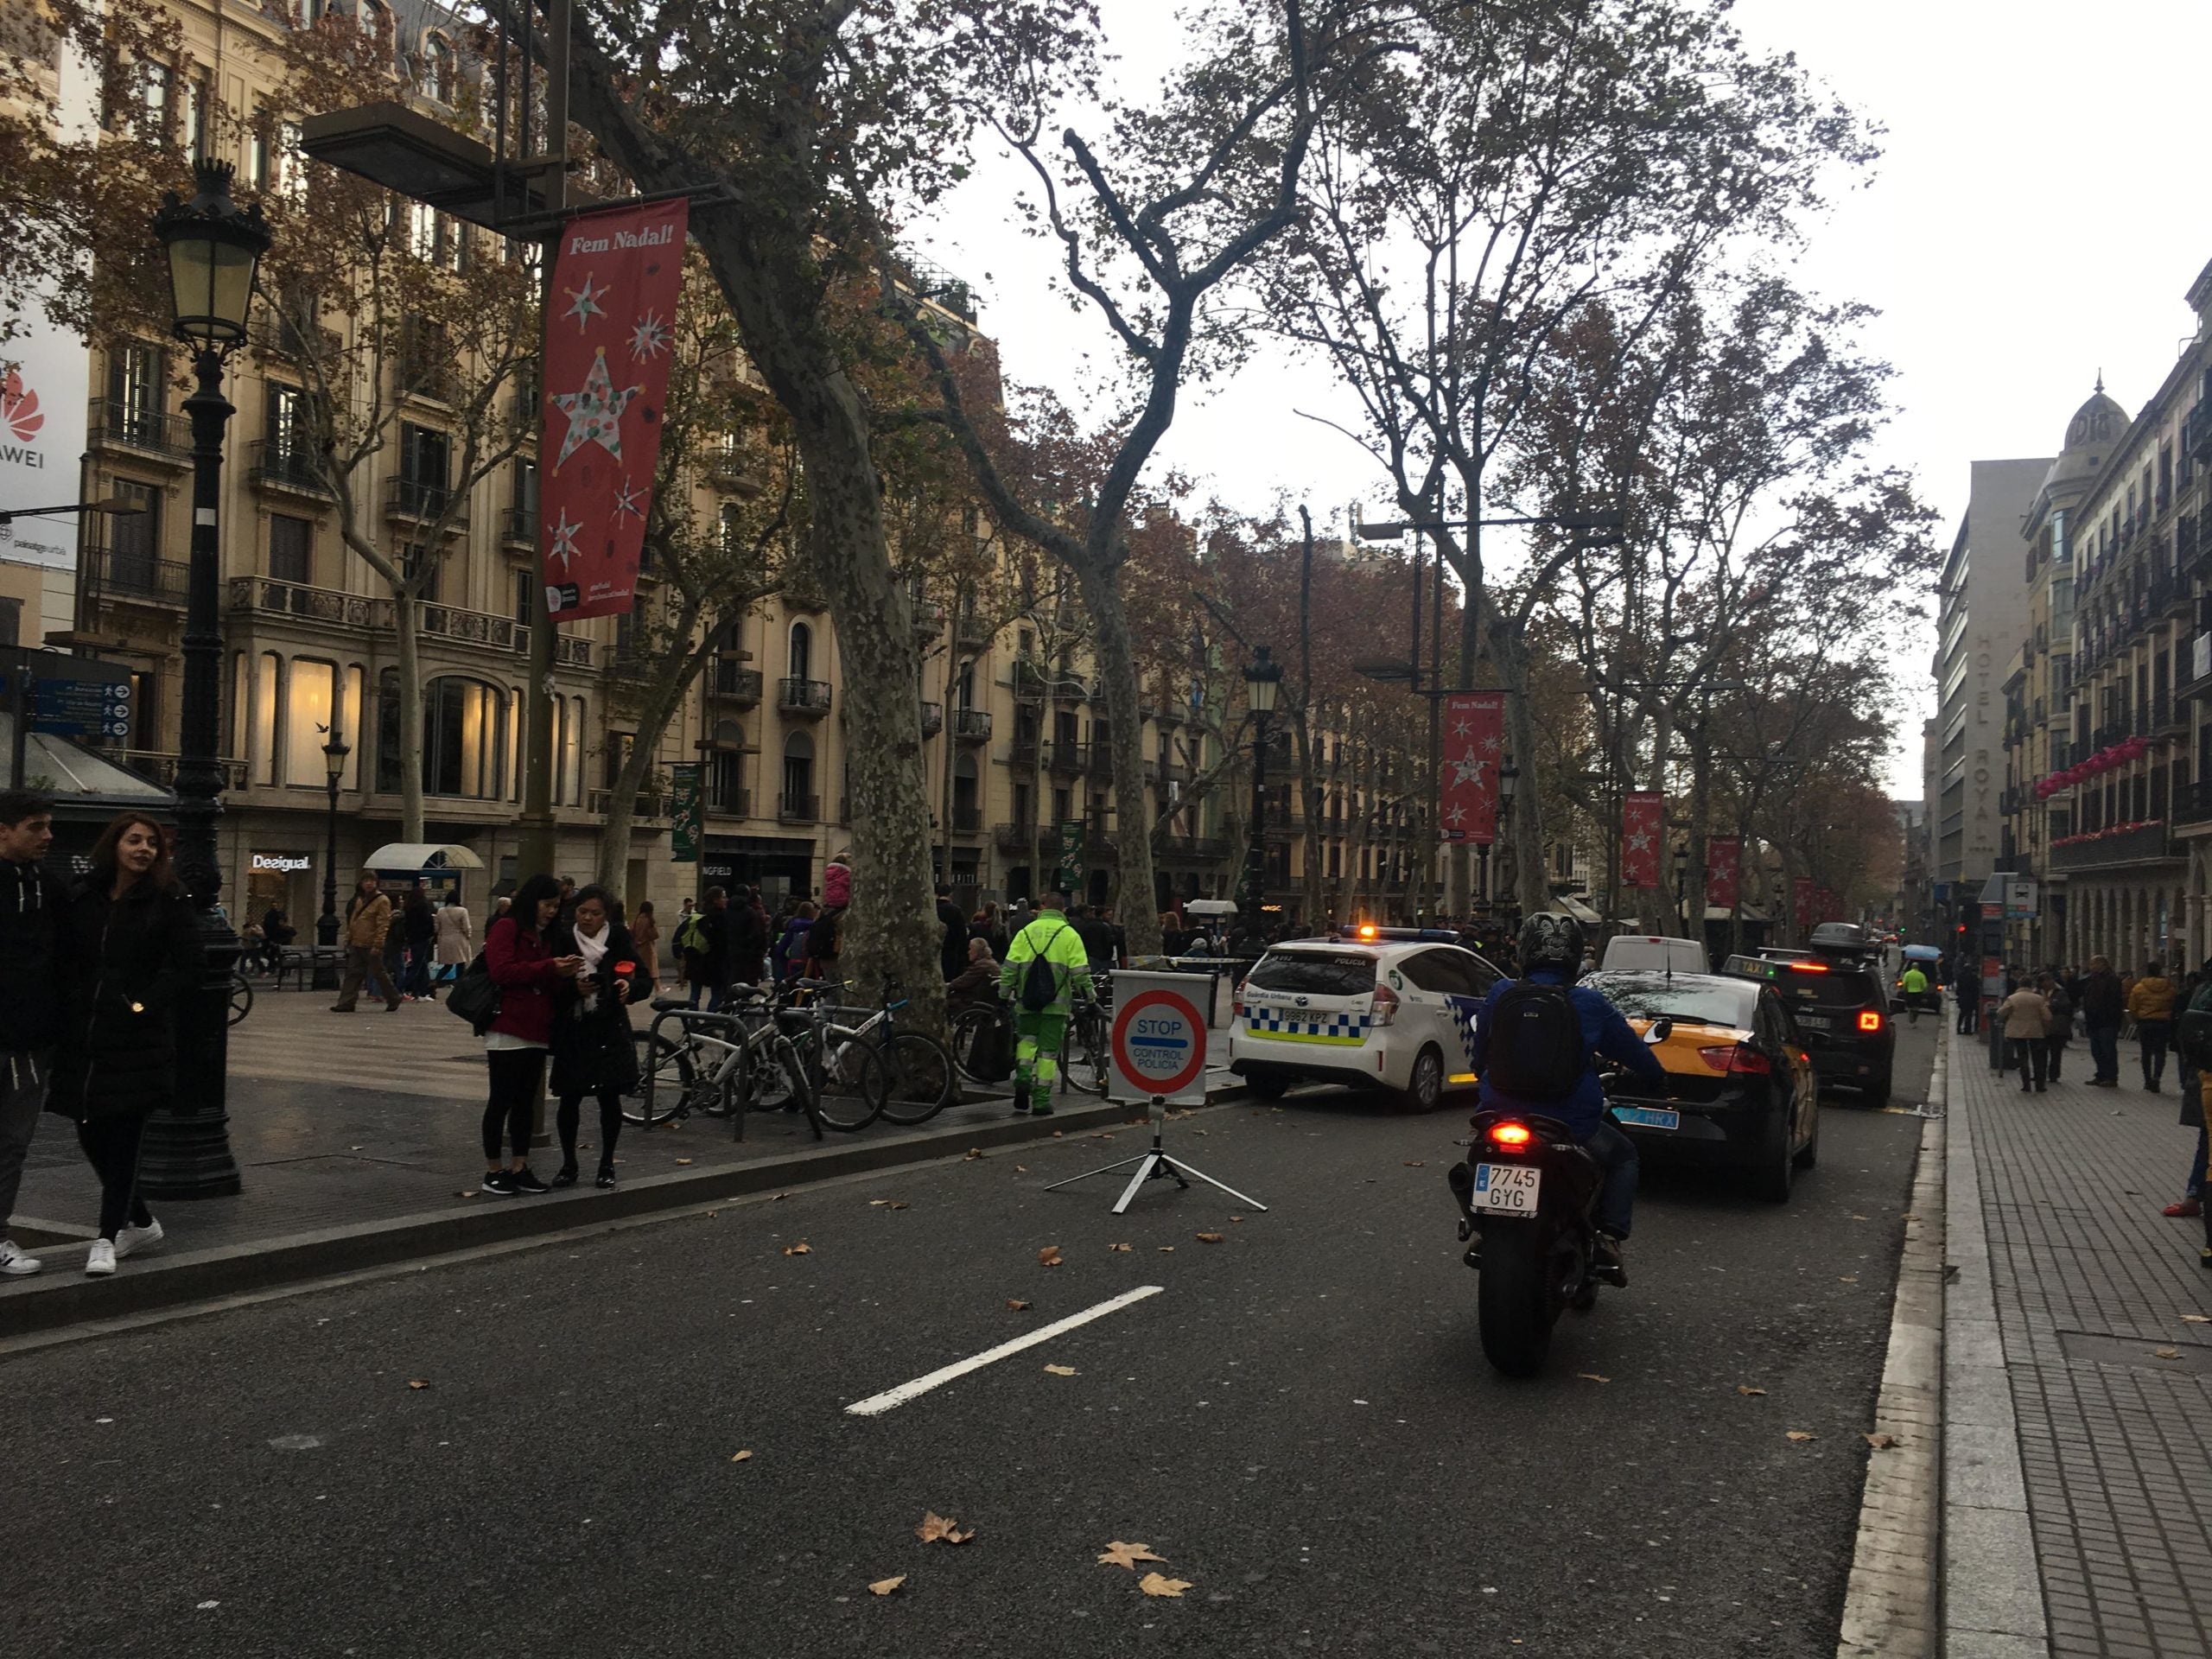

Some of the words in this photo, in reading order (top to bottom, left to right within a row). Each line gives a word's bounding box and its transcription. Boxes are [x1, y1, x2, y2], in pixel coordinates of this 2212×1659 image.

[569, 237, 608, 255] Fem
[613, 225, 674, 250] Nadal!
[1977, 635, 1991, 724] HOTEL
[1451, 701, 1470, 709] Fem
[1471, 701, 1498, 709] Nadal!
[1974, 748, 1989, 840] ROYAL
[1334, 957, 1367, 967] POLICIA
[1742, 961, 1764, 975] TAXI
[1309, 1012, 1328, 1023] KPZ
[1137, 1020, 1182, 1035] STOP
[1133, 1048, 1184, 1060] CONTROL
[1137, 1058, 1179, 1070] POLICIA
[1491, 1168, 1535, 1188] 7745
[1490, 1188, 1524, 1207] GYG
